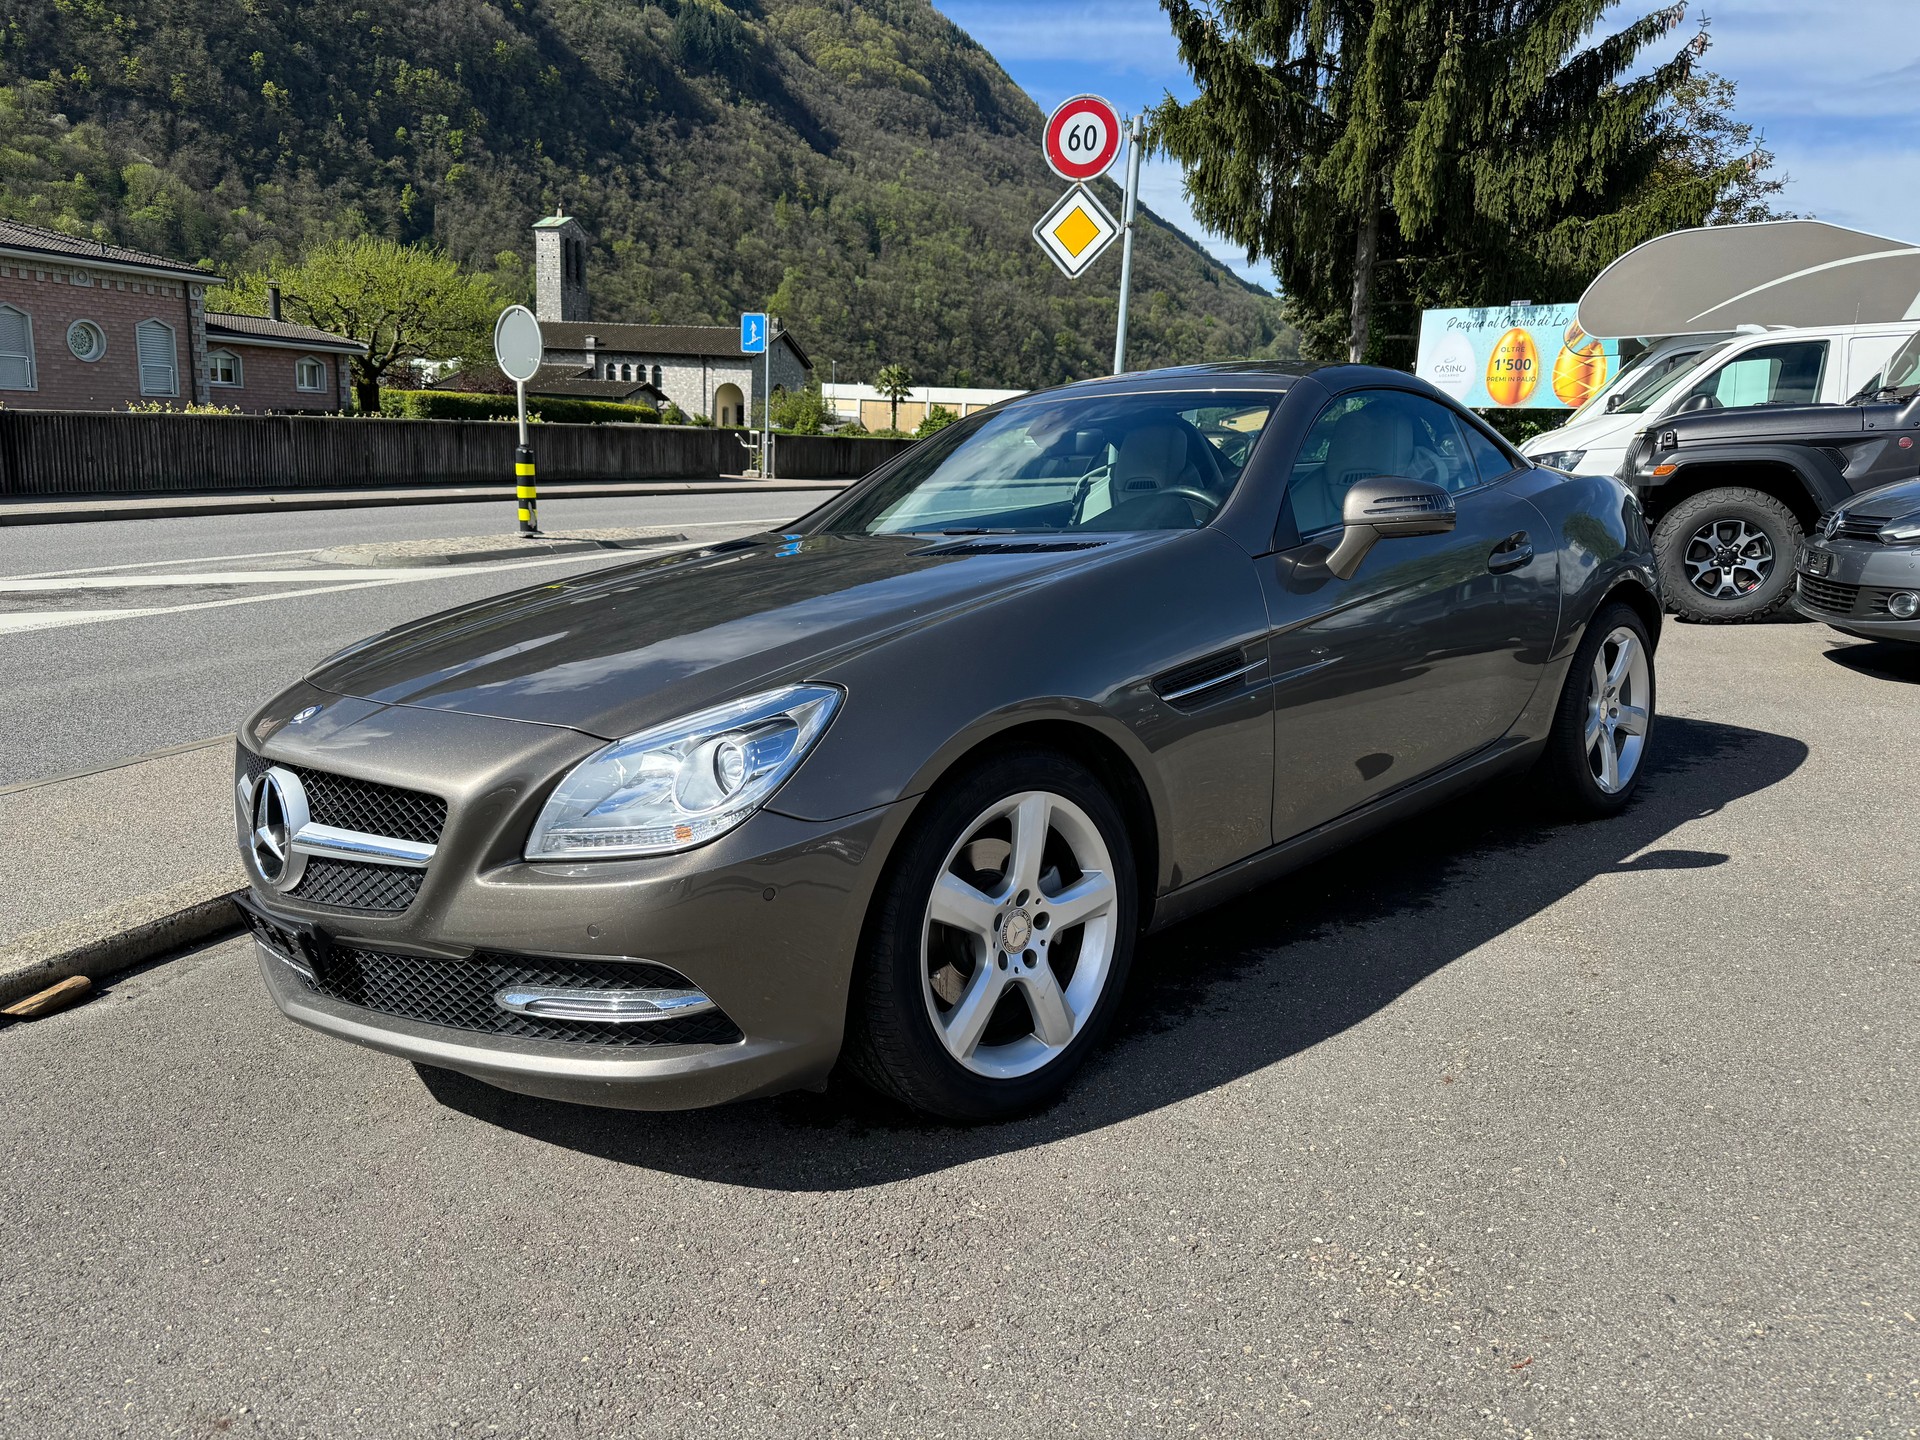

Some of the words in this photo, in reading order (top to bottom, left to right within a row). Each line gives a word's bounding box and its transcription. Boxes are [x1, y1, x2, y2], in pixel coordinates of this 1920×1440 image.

[1068, 124, 1097, 152] 60
[1447, 317, 1485, 332] Pasqua
[1487, 316, 1500, 329] al
[1537, 314, 1550, 327] di
[1434, 364, 1467, 373] CASINO
[1494, 358, 1532, 371] 1'500
